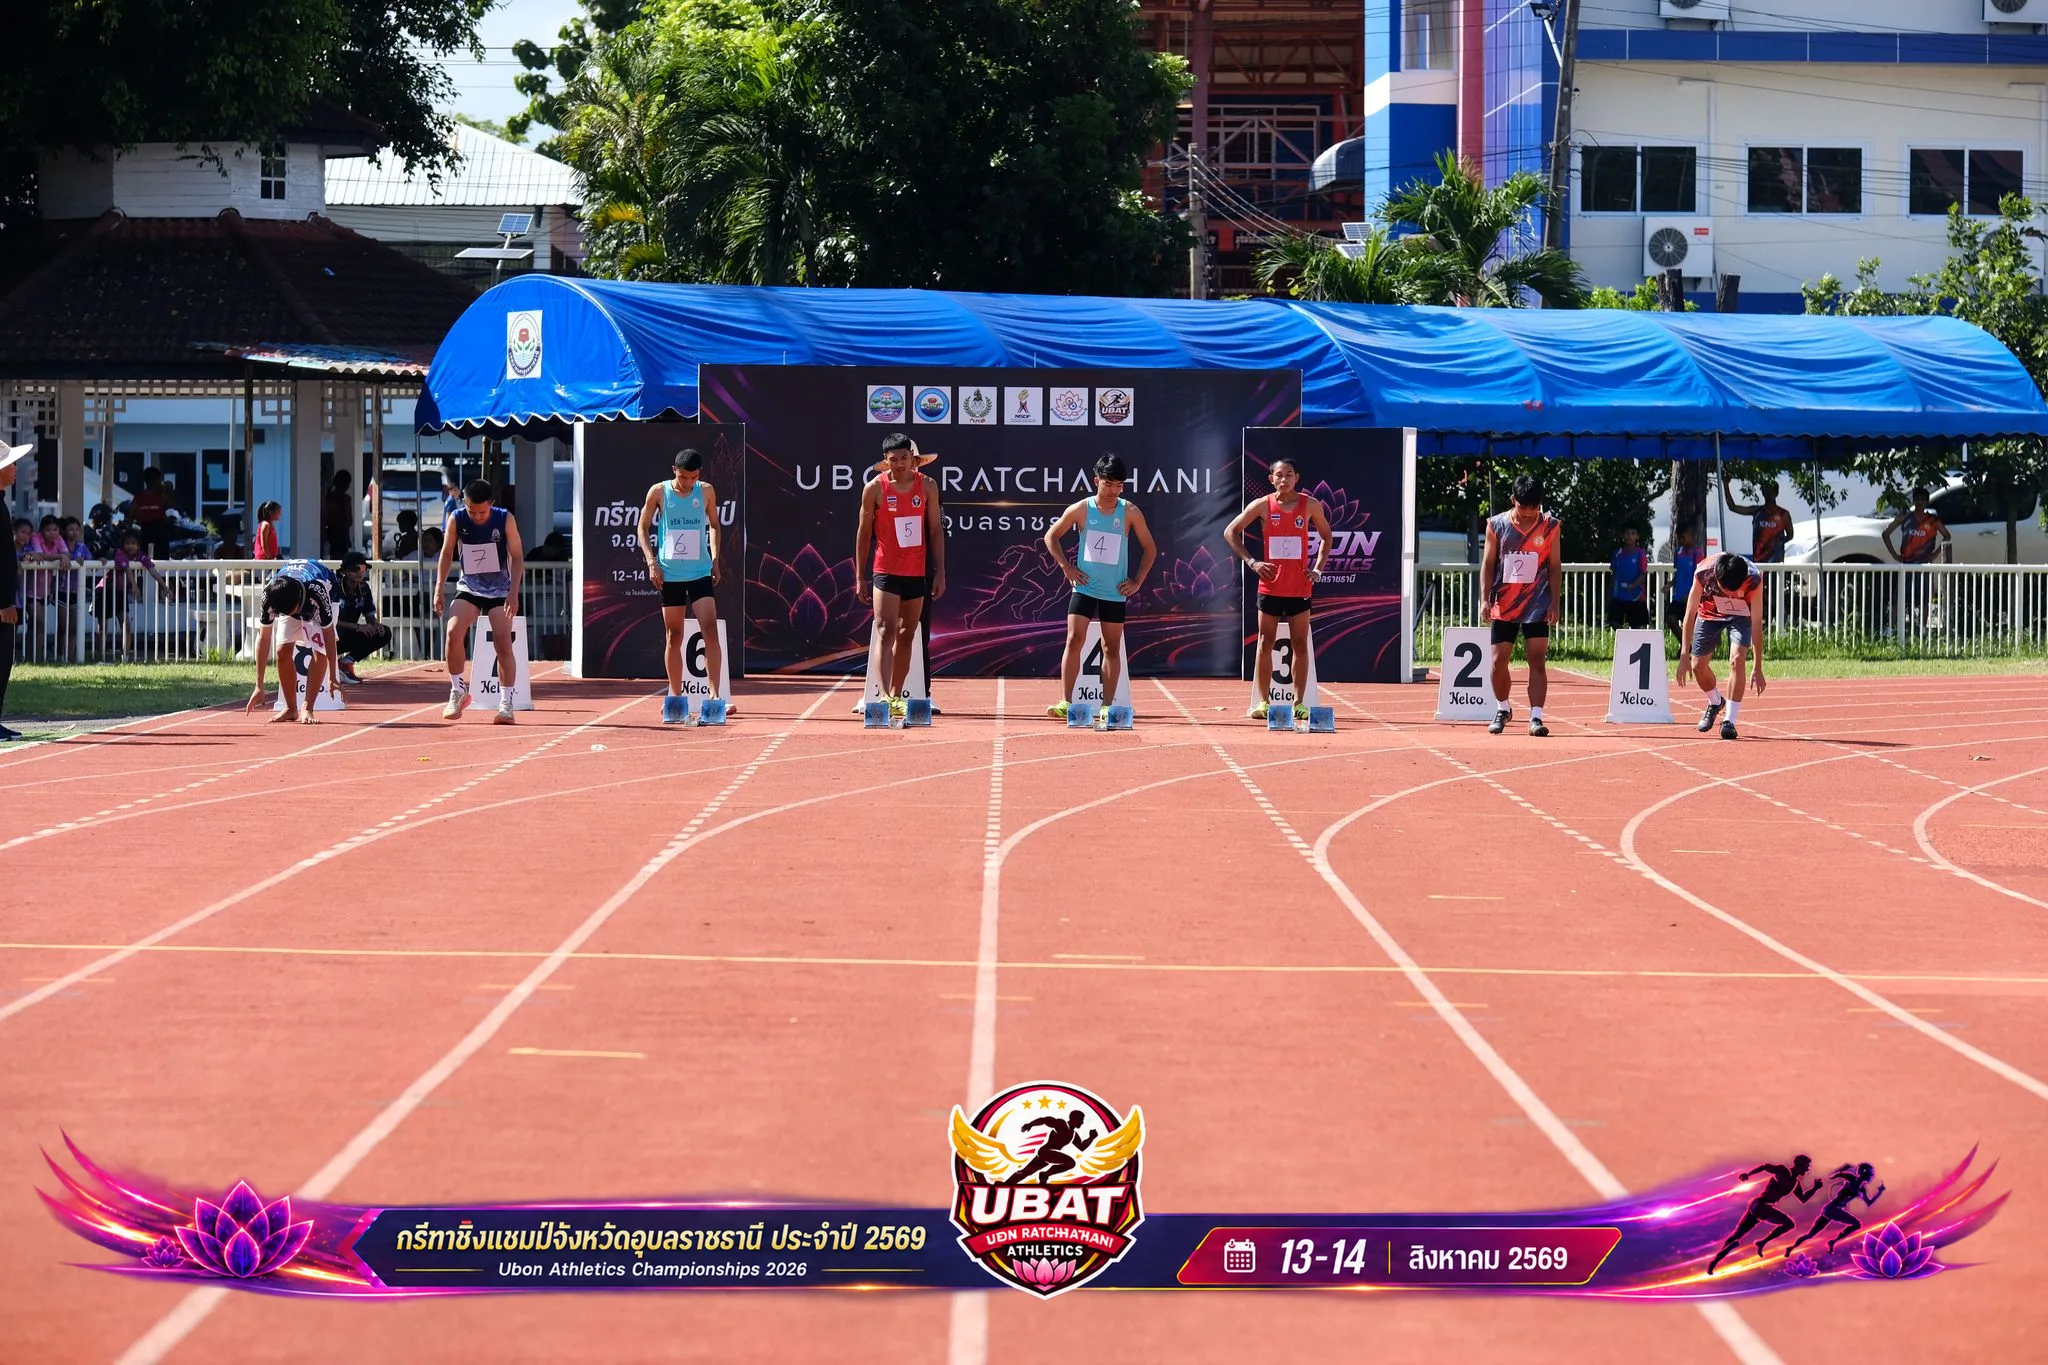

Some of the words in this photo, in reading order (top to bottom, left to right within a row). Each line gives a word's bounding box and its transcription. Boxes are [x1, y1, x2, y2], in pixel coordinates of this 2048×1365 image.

[1101, 406, 1127, 414] UBAT
[942, 466, 1211, 494] RATCHAHANI
[904, 522, 914, 538] 5
[674, 533, 686, 553] 6
[1093, 535, 1108, 556] 4
[471, 549, 487, 568] 7
[1512, 559, 1524, 577] 2
[685, 631, 709, 678] 6
[1082, 637, 1104, 684] 4
[1271, 638, 1294, 685] 3
[1453, 642, 1483, 688] 2
[1629, 643, 1652, 690] 1
[1449, 691, 1484, 706] Nelco
[1620, 691, 1654, 707] Nelco
